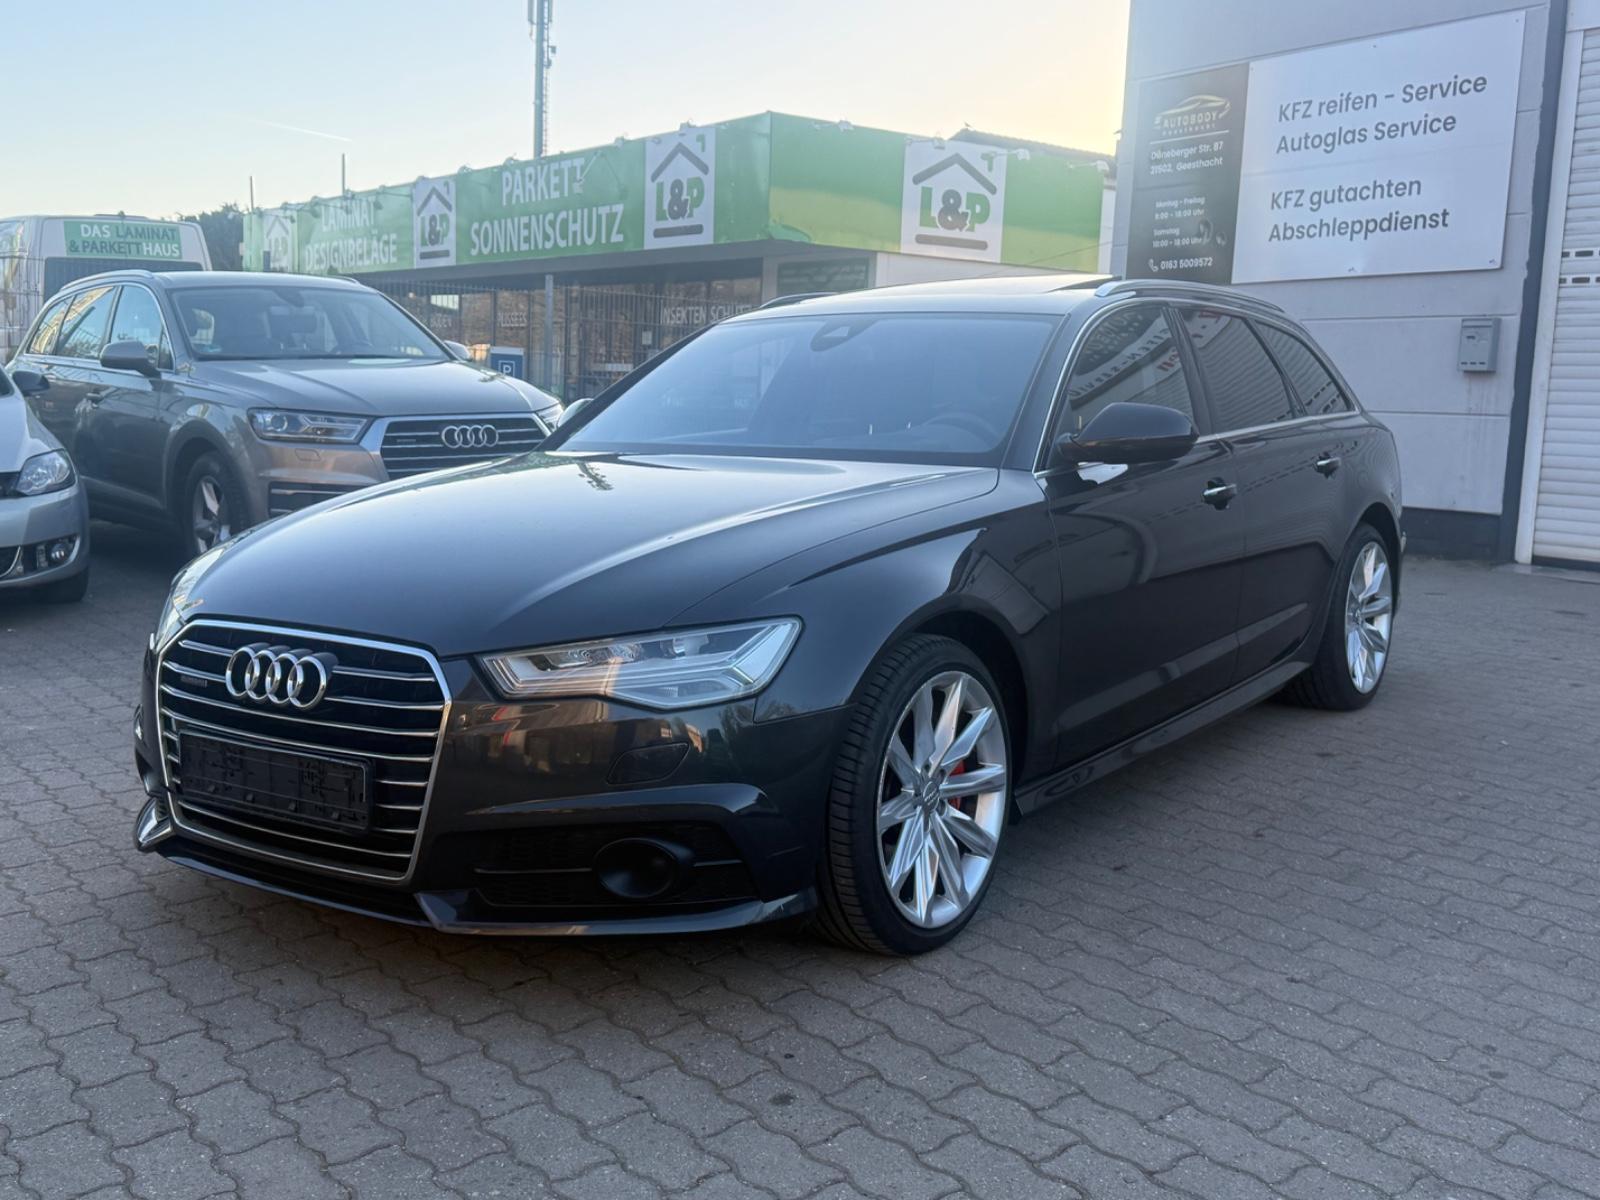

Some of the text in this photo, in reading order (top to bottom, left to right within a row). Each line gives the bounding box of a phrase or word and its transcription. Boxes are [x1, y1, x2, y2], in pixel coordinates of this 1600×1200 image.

[1278, 100, 1312, 122] KFZ
[1317, 91, 1377, 117] reifen
[1401, 75, 1488, 103] Service
[1162, 111, 1217, 128] AUTOBODY
[1276, 113, 1457, 153] Autoglas Service
[502, 156, 585, 206] PARKETT
[1271, 178, 1422, 212] KFZ gutachten
[321, 199, 377, 232] LAMINAT
[656, 176, 705, 221] L&P
[919, 186, 991, 233] L&P
[80, 224, 177, 240] DAS LAMINAT
[420, 213, 450, 247] L&P
[470, 203, 625, 256] SONNENSCHUTZ
[1268, 208, 1449, 242] Abschleppdienst
[81, 240, 181, 258] PARKETTHAUS
[305, 229, 398, 269] DESIGNBELÄGE
[503, 364, 512, 374] P
